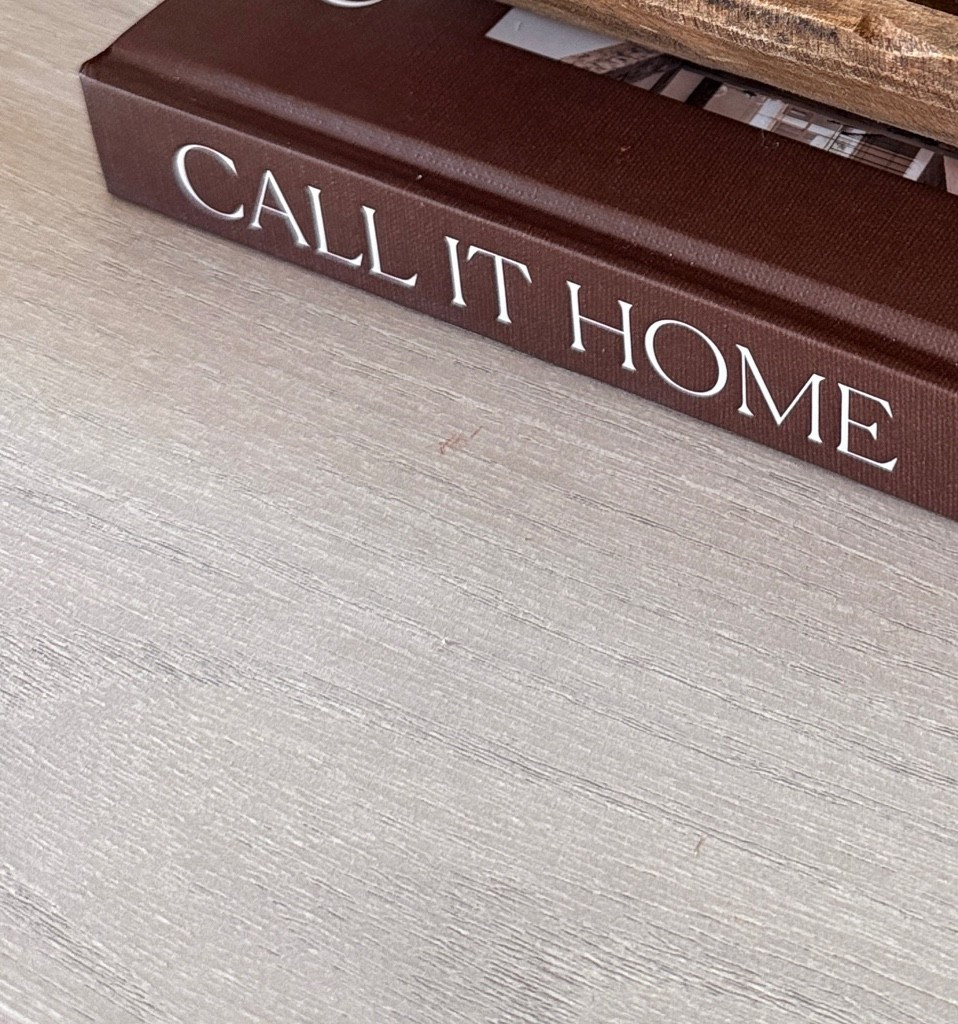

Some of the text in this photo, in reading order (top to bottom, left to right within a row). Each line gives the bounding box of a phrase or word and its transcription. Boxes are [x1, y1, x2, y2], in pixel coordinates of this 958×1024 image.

[173, 144, 898, 472] CALL IT HOME
